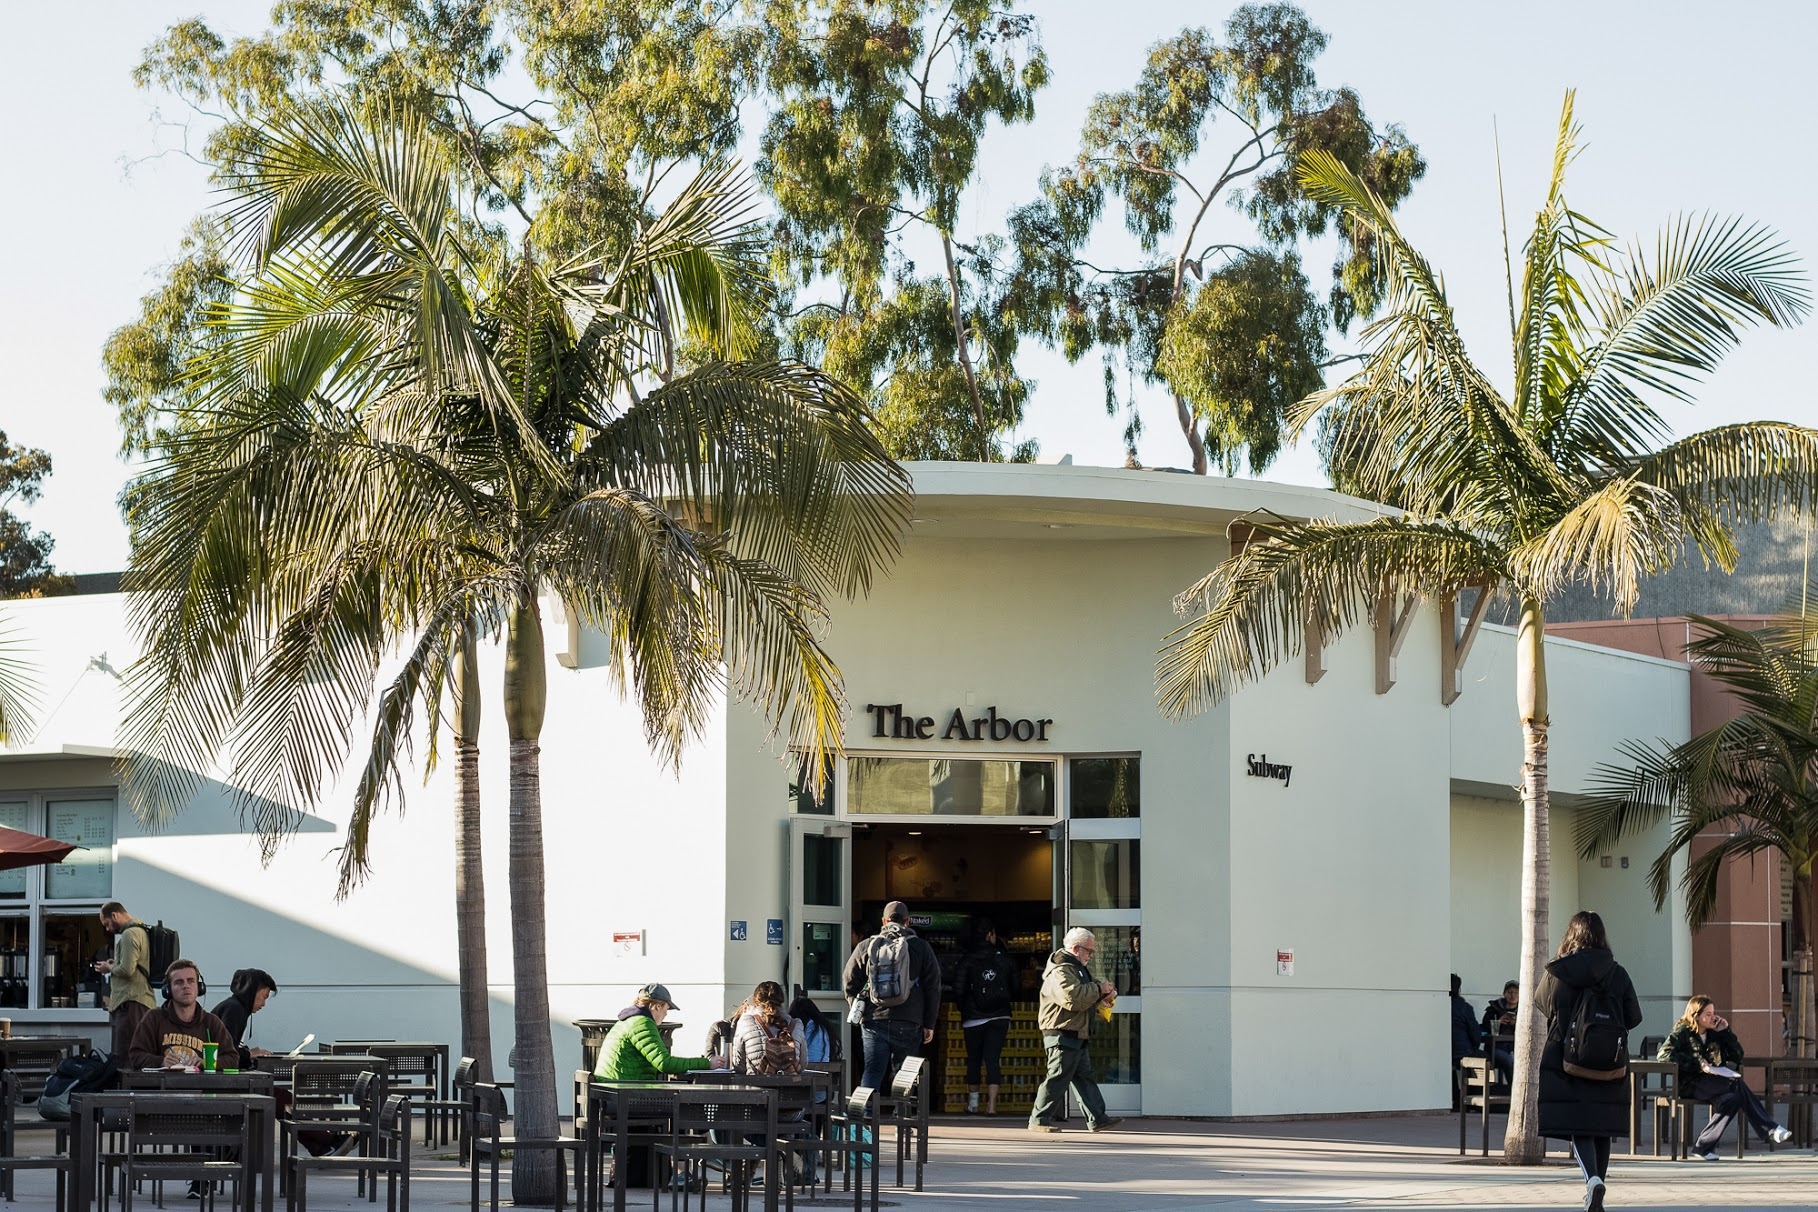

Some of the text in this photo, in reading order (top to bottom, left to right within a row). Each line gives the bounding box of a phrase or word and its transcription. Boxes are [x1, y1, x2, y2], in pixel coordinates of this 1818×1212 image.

[866, 703, 1053, 742] The Arbor
[1247, 753, 1294, 788] Subway
[910, 916, 930, 925] Naked
[162, 1033, 204, 1053] MISSION
